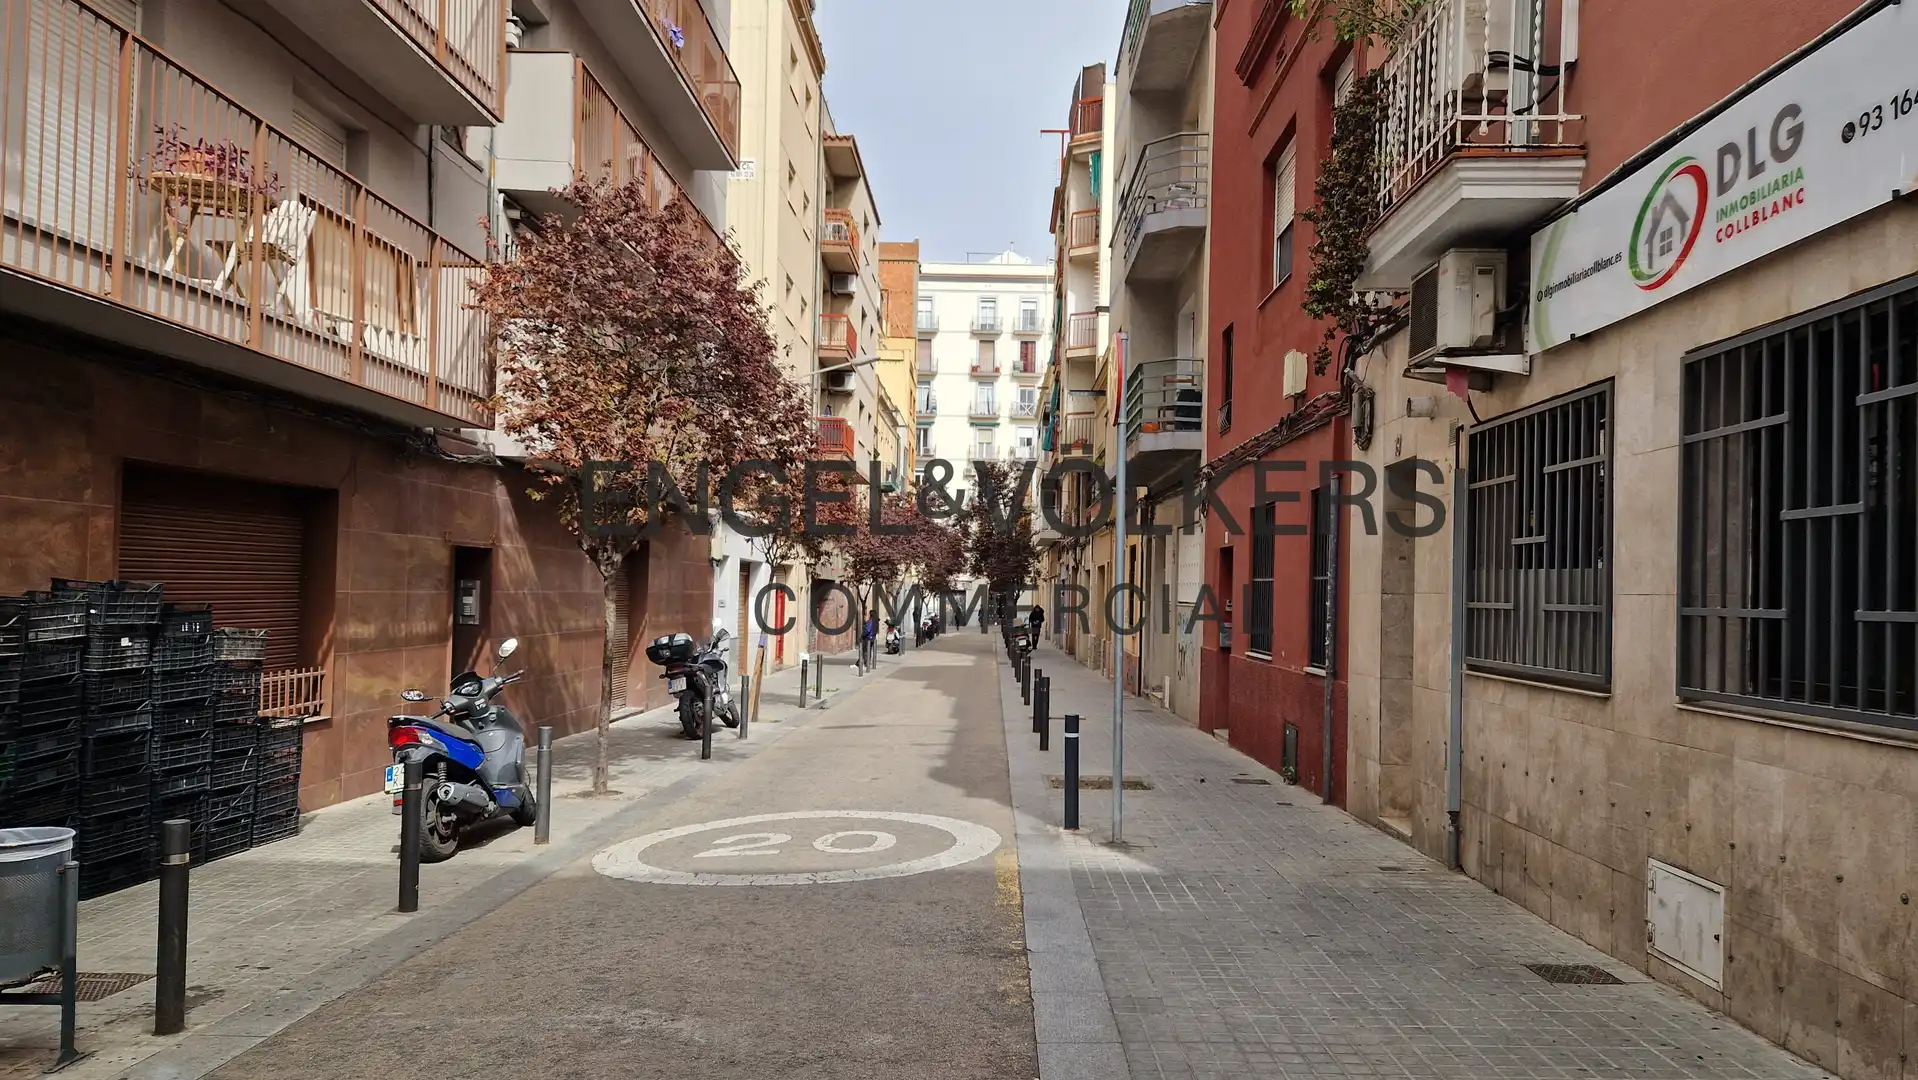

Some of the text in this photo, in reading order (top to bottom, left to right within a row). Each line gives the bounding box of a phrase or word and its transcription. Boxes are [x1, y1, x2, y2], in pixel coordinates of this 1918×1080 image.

[1859, 104, 1883, 137] 93
[1717, 103, 1804, 198] DLG
[1716, 166, 1804, 223] INMOBILIARIA
[1716, 187, 1804, 243] COLLBLANC
[1543, 251, 1622, 299] dlginmobiliariacollblanc.es
[693, 830, 896, 859] 20
